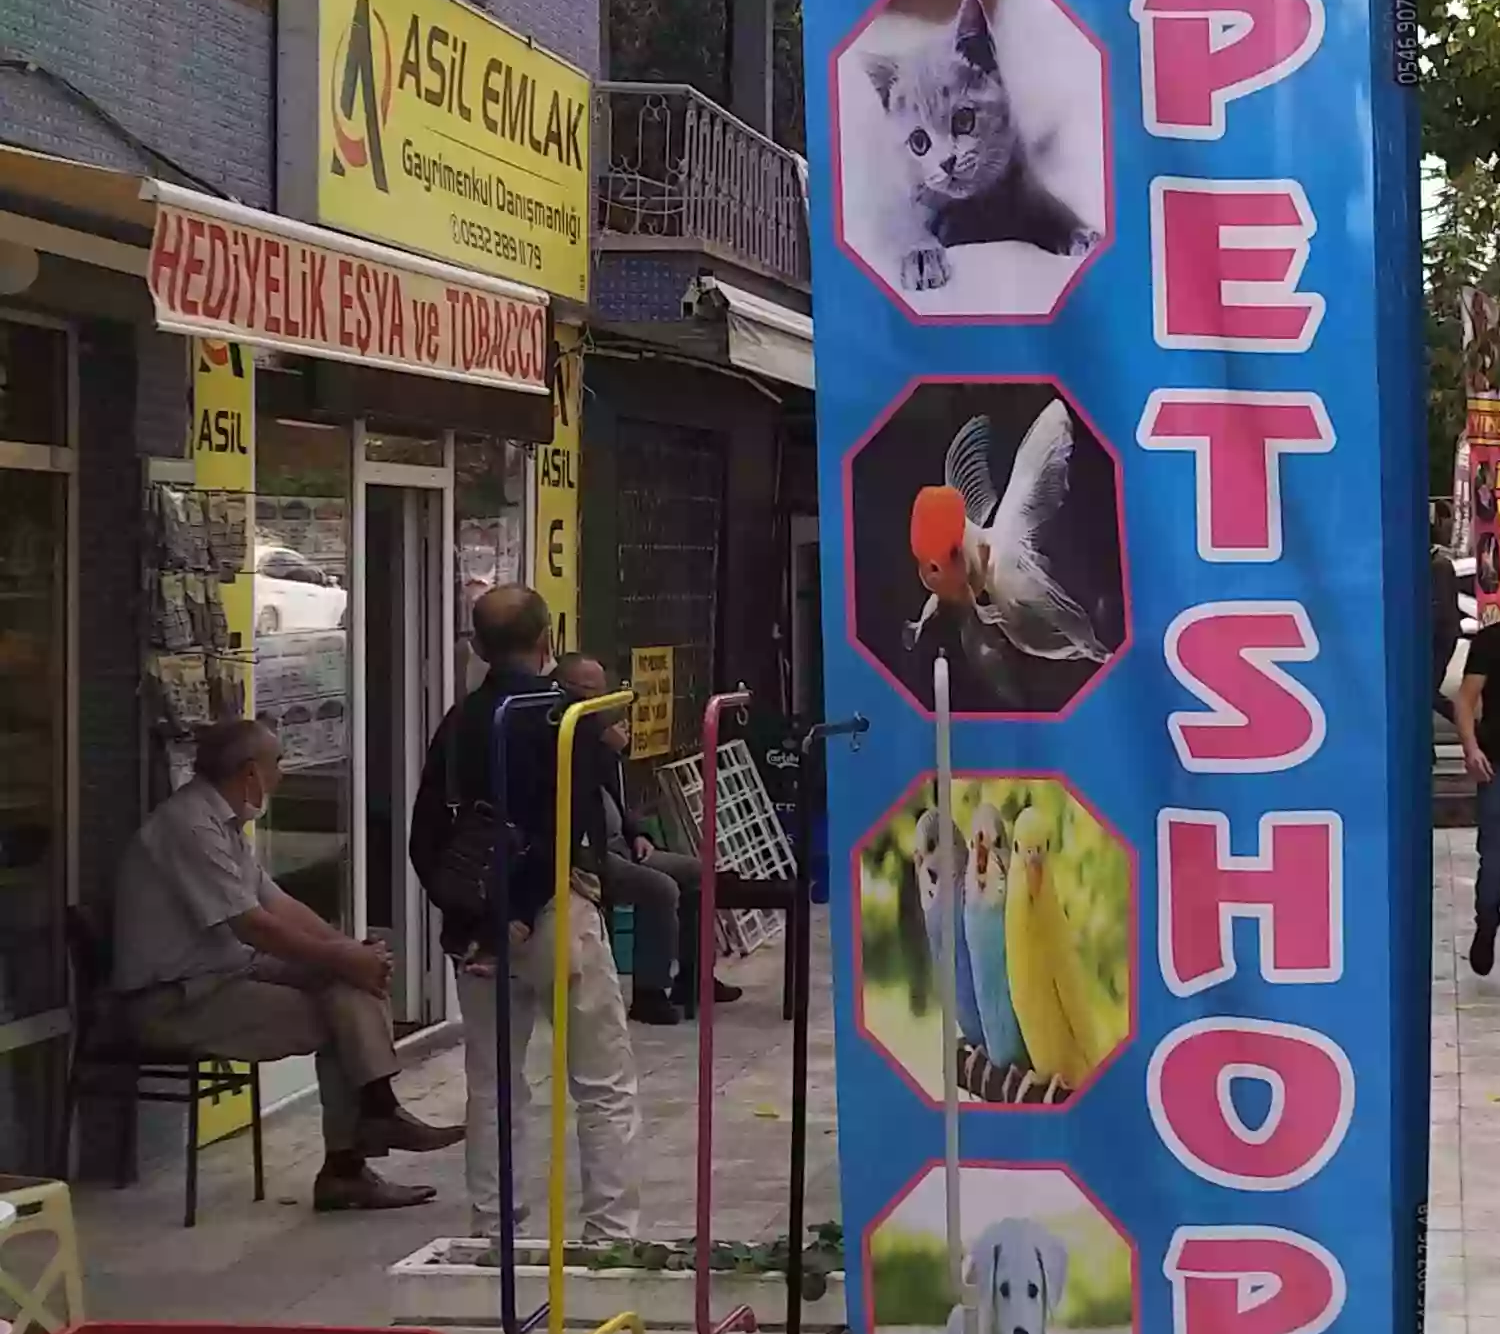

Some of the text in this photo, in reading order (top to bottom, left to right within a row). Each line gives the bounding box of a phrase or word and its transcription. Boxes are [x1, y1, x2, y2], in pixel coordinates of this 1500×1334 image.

[1396, 0, 1417, 33] 907
[1397, 38, 1418, 85] 0546
[482, 56, 585, 172] EMLAK
[402, 138, 492, 208] Gayrimenkul
[460, 218, 492, 253] 0532
[412, 299, 440, 364] ve
[446, 287, 545, 381] TOBACCO
